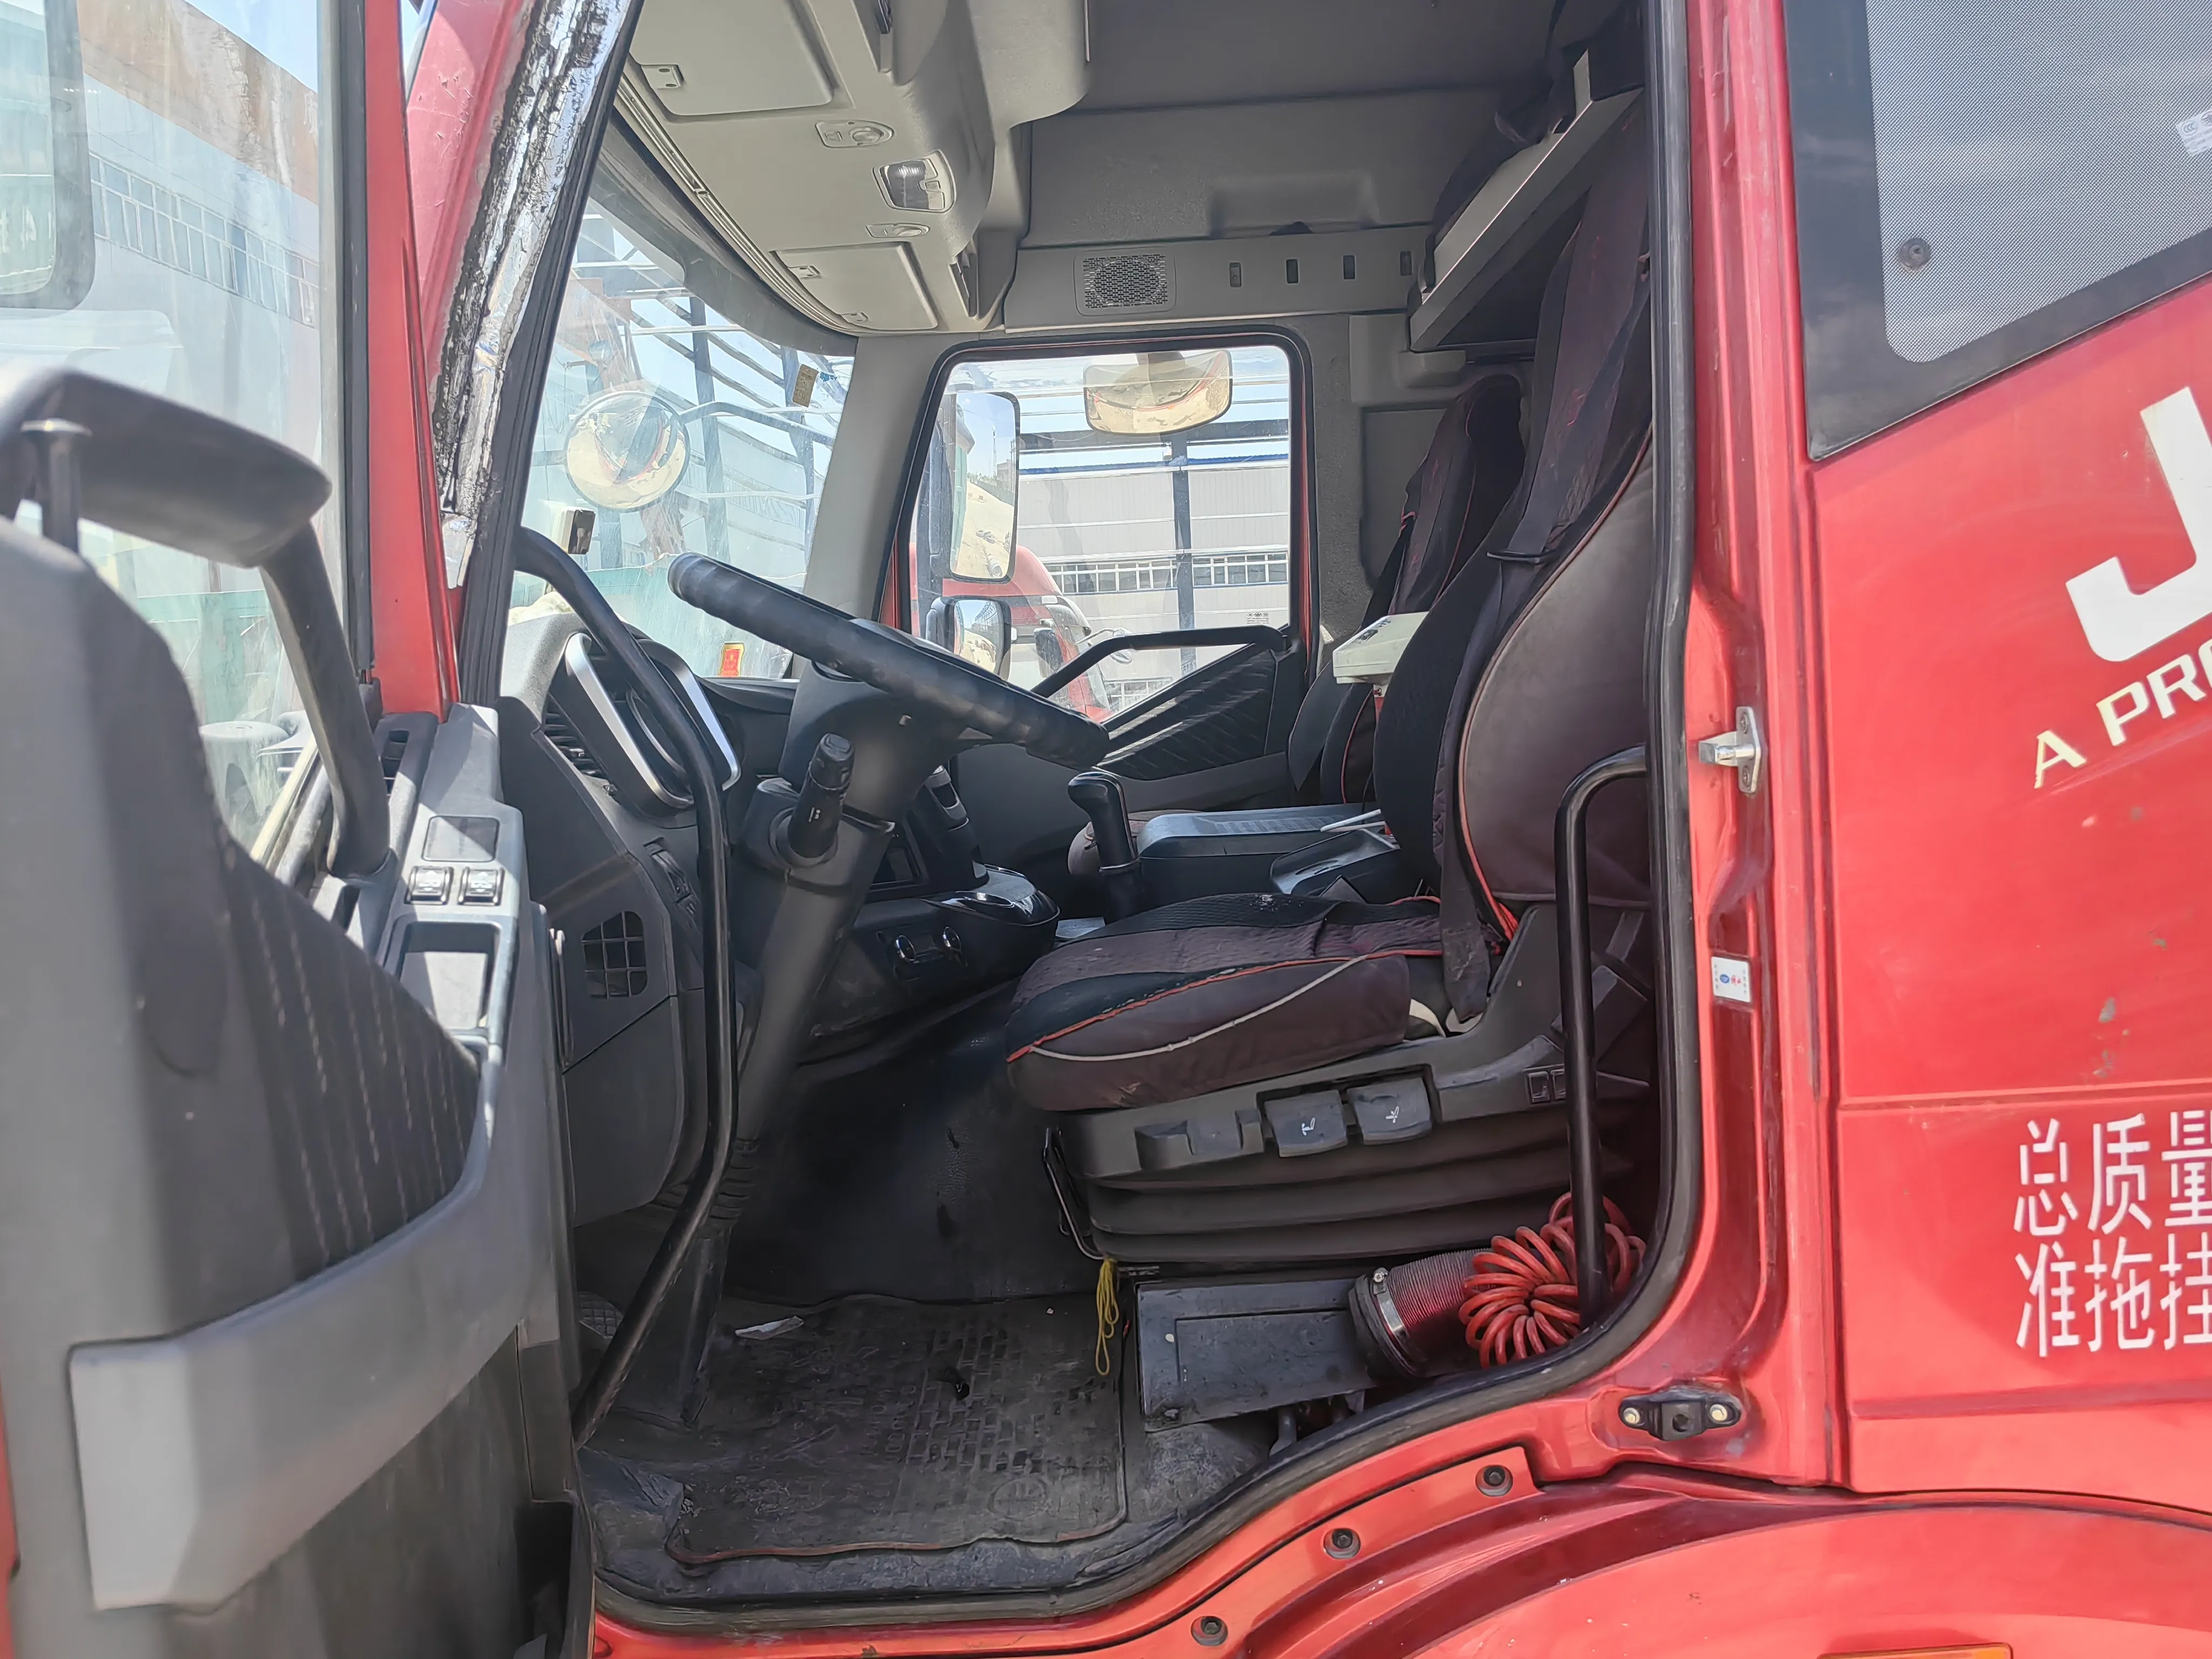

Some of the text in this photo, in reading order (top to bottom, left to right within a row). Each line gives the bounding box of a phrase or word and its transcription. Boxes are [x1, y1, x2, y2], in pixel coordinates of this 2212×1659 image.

[2066, 386, 2212, 662] J
[2034, 730, 2086, 789] A
[2014, 1110, 2212, 1236] 总质量
[2015, 1232, 2212, 1357] 准拖挂
